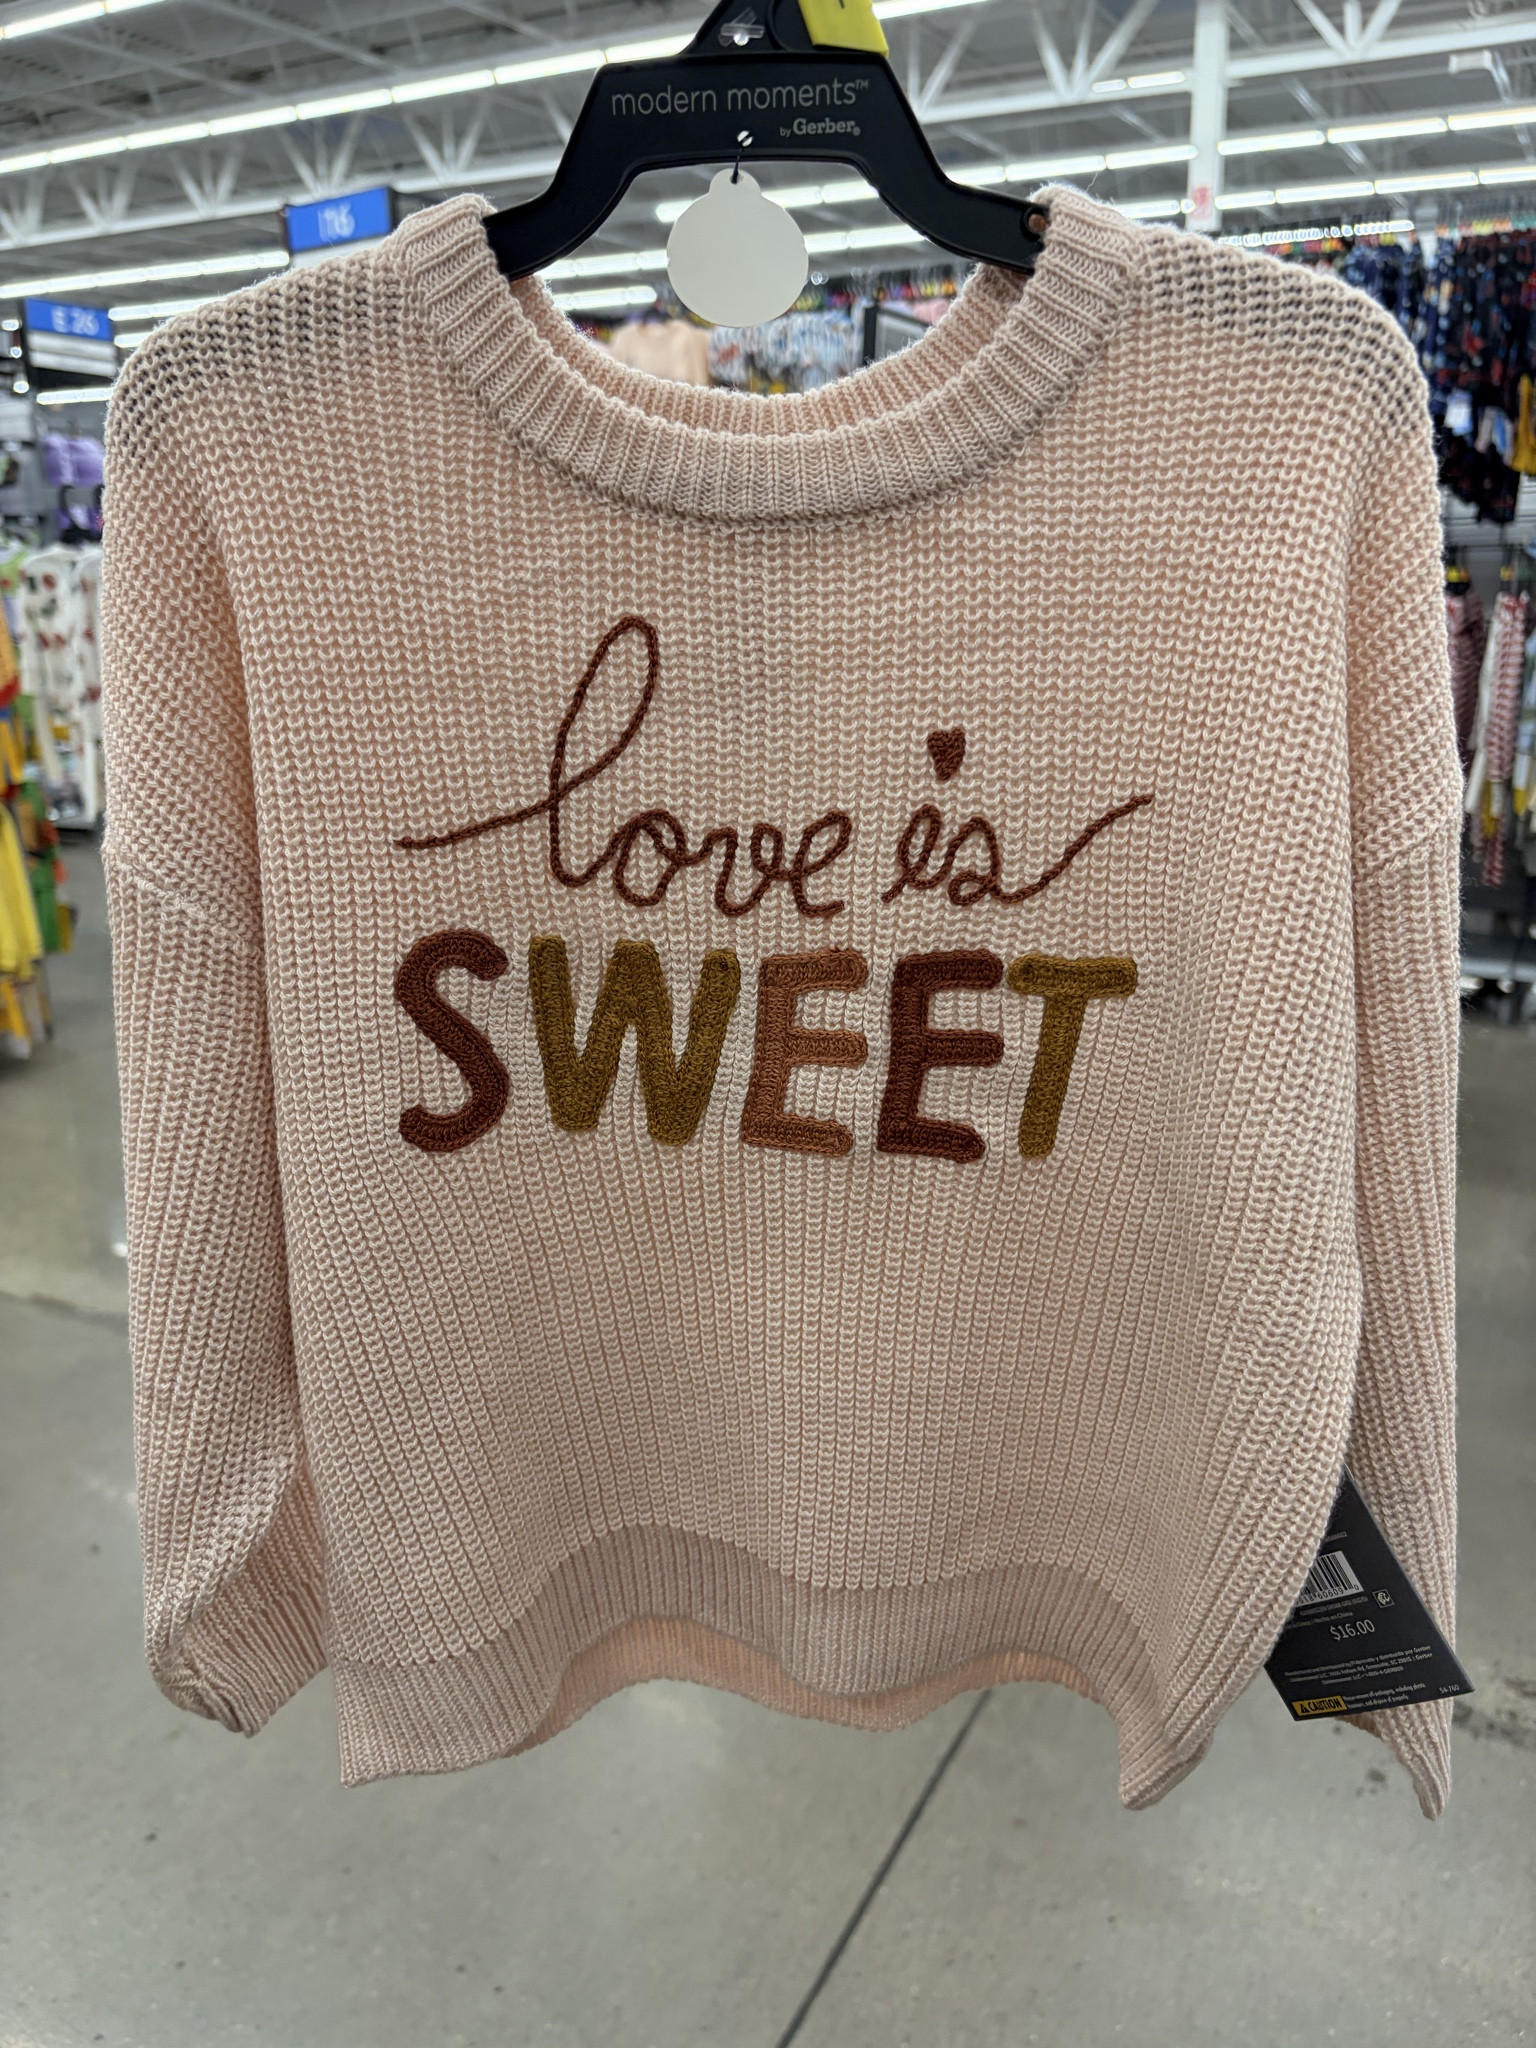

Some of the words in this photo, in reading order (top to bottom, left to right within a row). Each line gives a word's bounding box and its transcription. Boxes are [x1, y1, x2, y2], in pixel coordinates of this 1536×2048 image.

[611, 85, 716, 116] modern
[779, 127, 791, 137] by
[393, 615, 852, 917] love
[881, 727, 1156, 905] is
[394, 928, 1139, 1164] SWEET
[1330, 1619, 1375, 1642] $16.00
[1307, 1697, 1343, 1712] CAUTION
